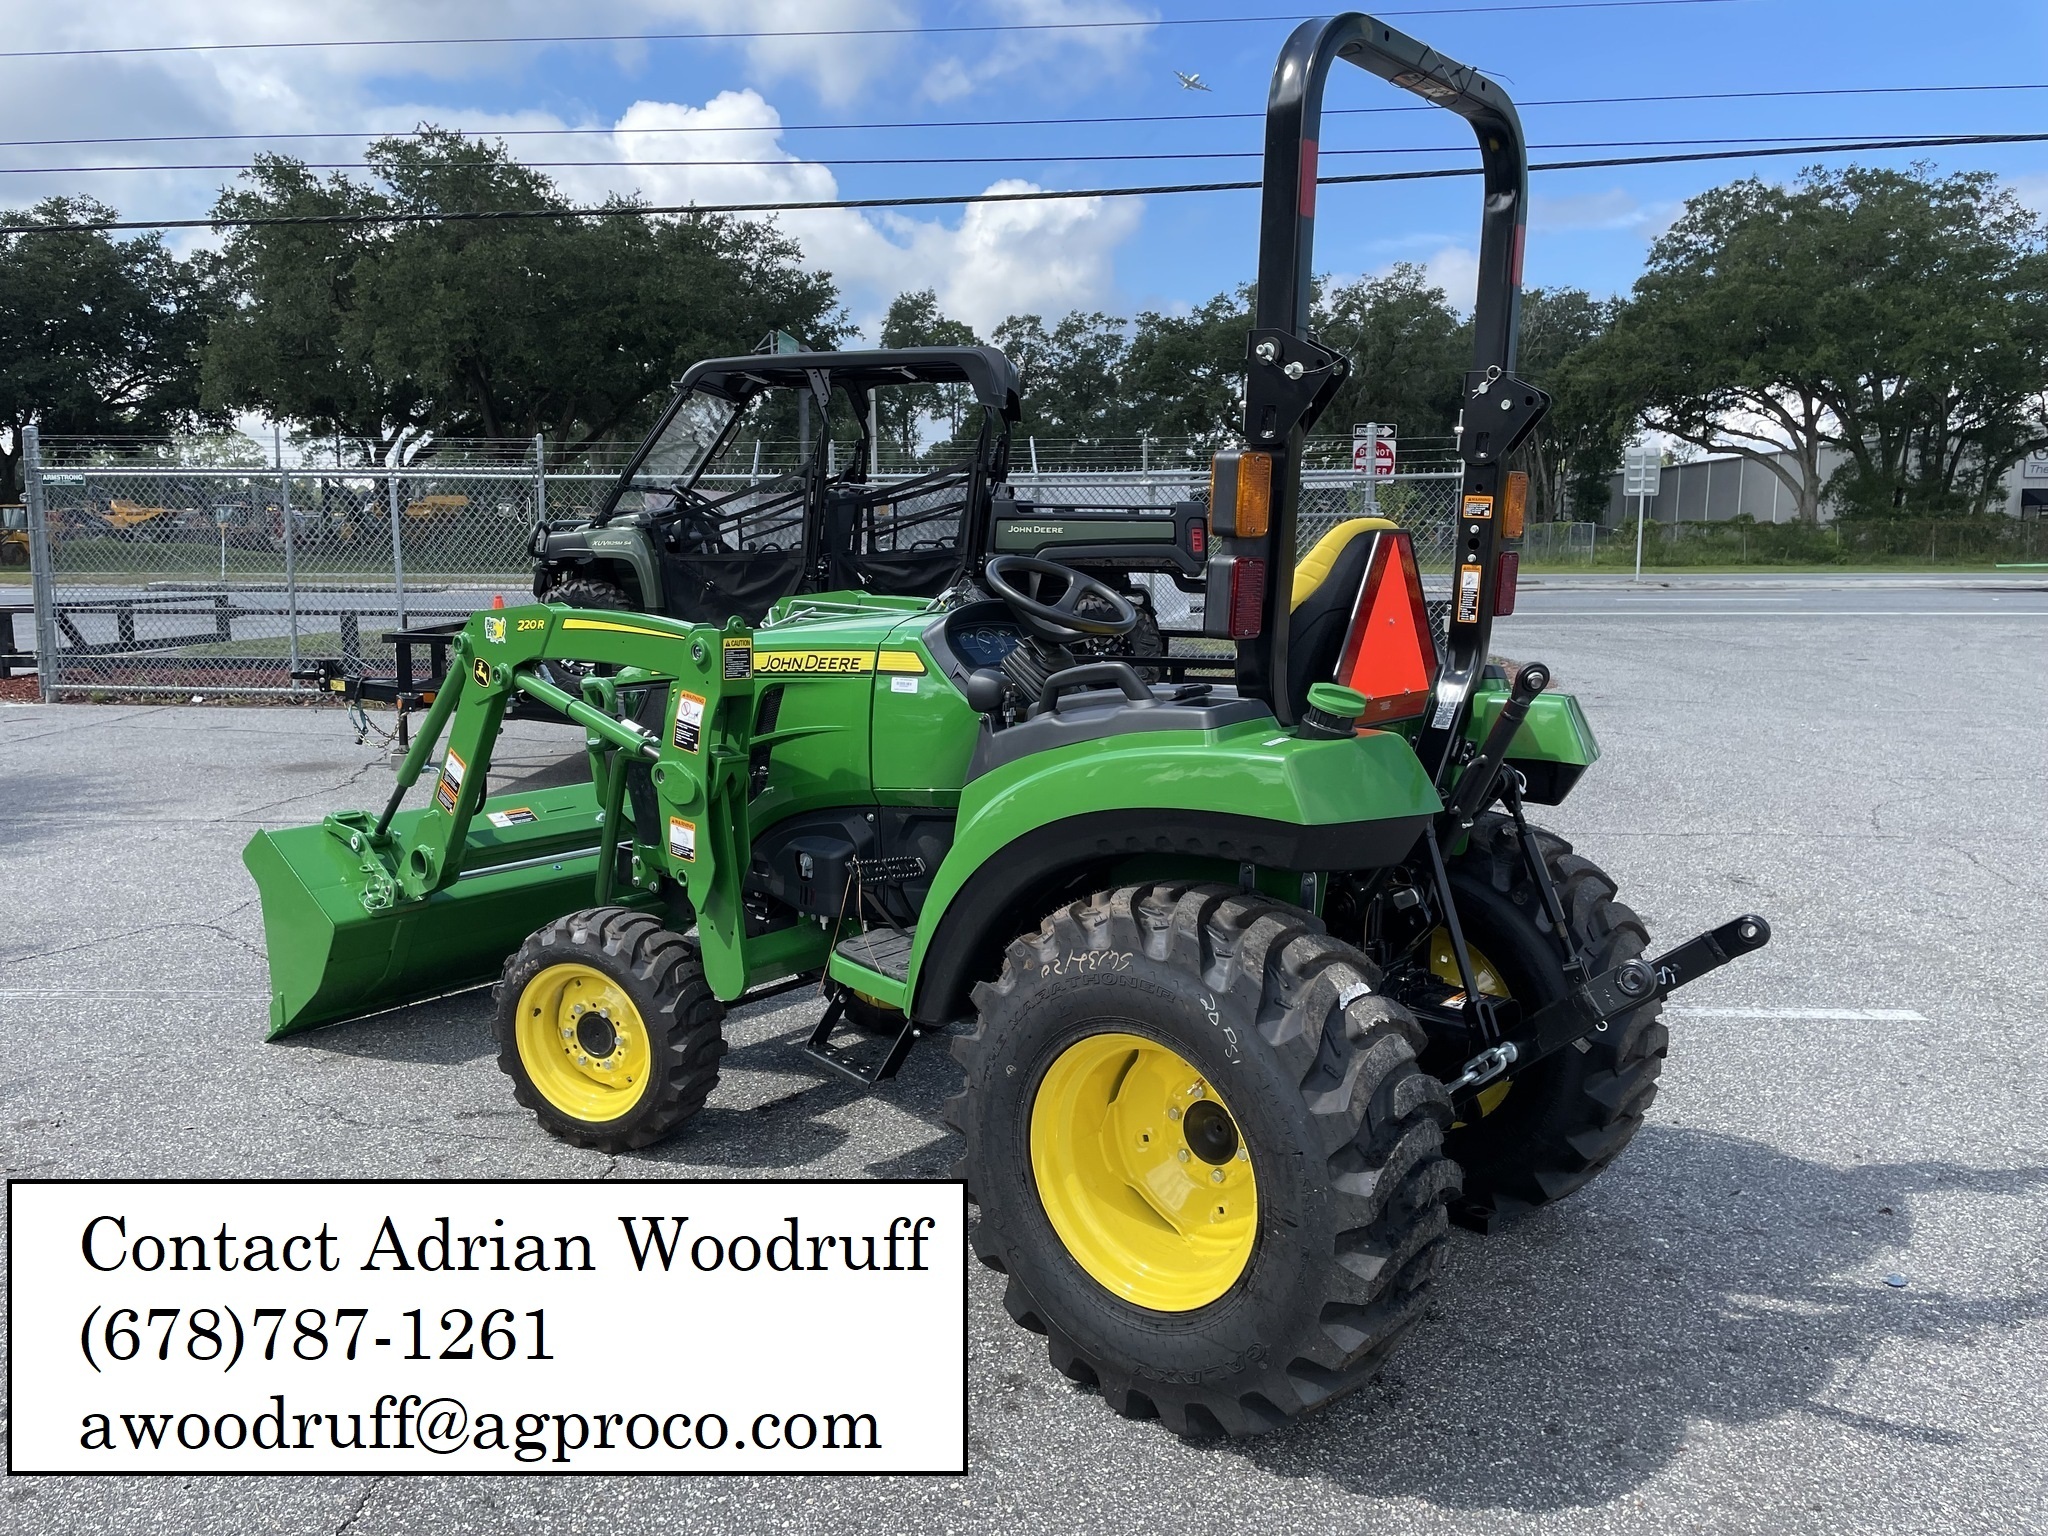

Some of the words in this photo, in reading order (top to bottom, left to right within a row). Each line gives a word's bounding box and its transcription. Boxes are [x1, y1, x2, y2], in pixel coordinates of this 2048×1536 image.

[1008, 525, 1032, 533] JOHN
[1033, 526, 1064, 534] DEERE
[761, 655, 803, 671] JOHN
[805, 654, 862, 671] DEERE
[1008, 972, 1177, 1030] MARATHONER
